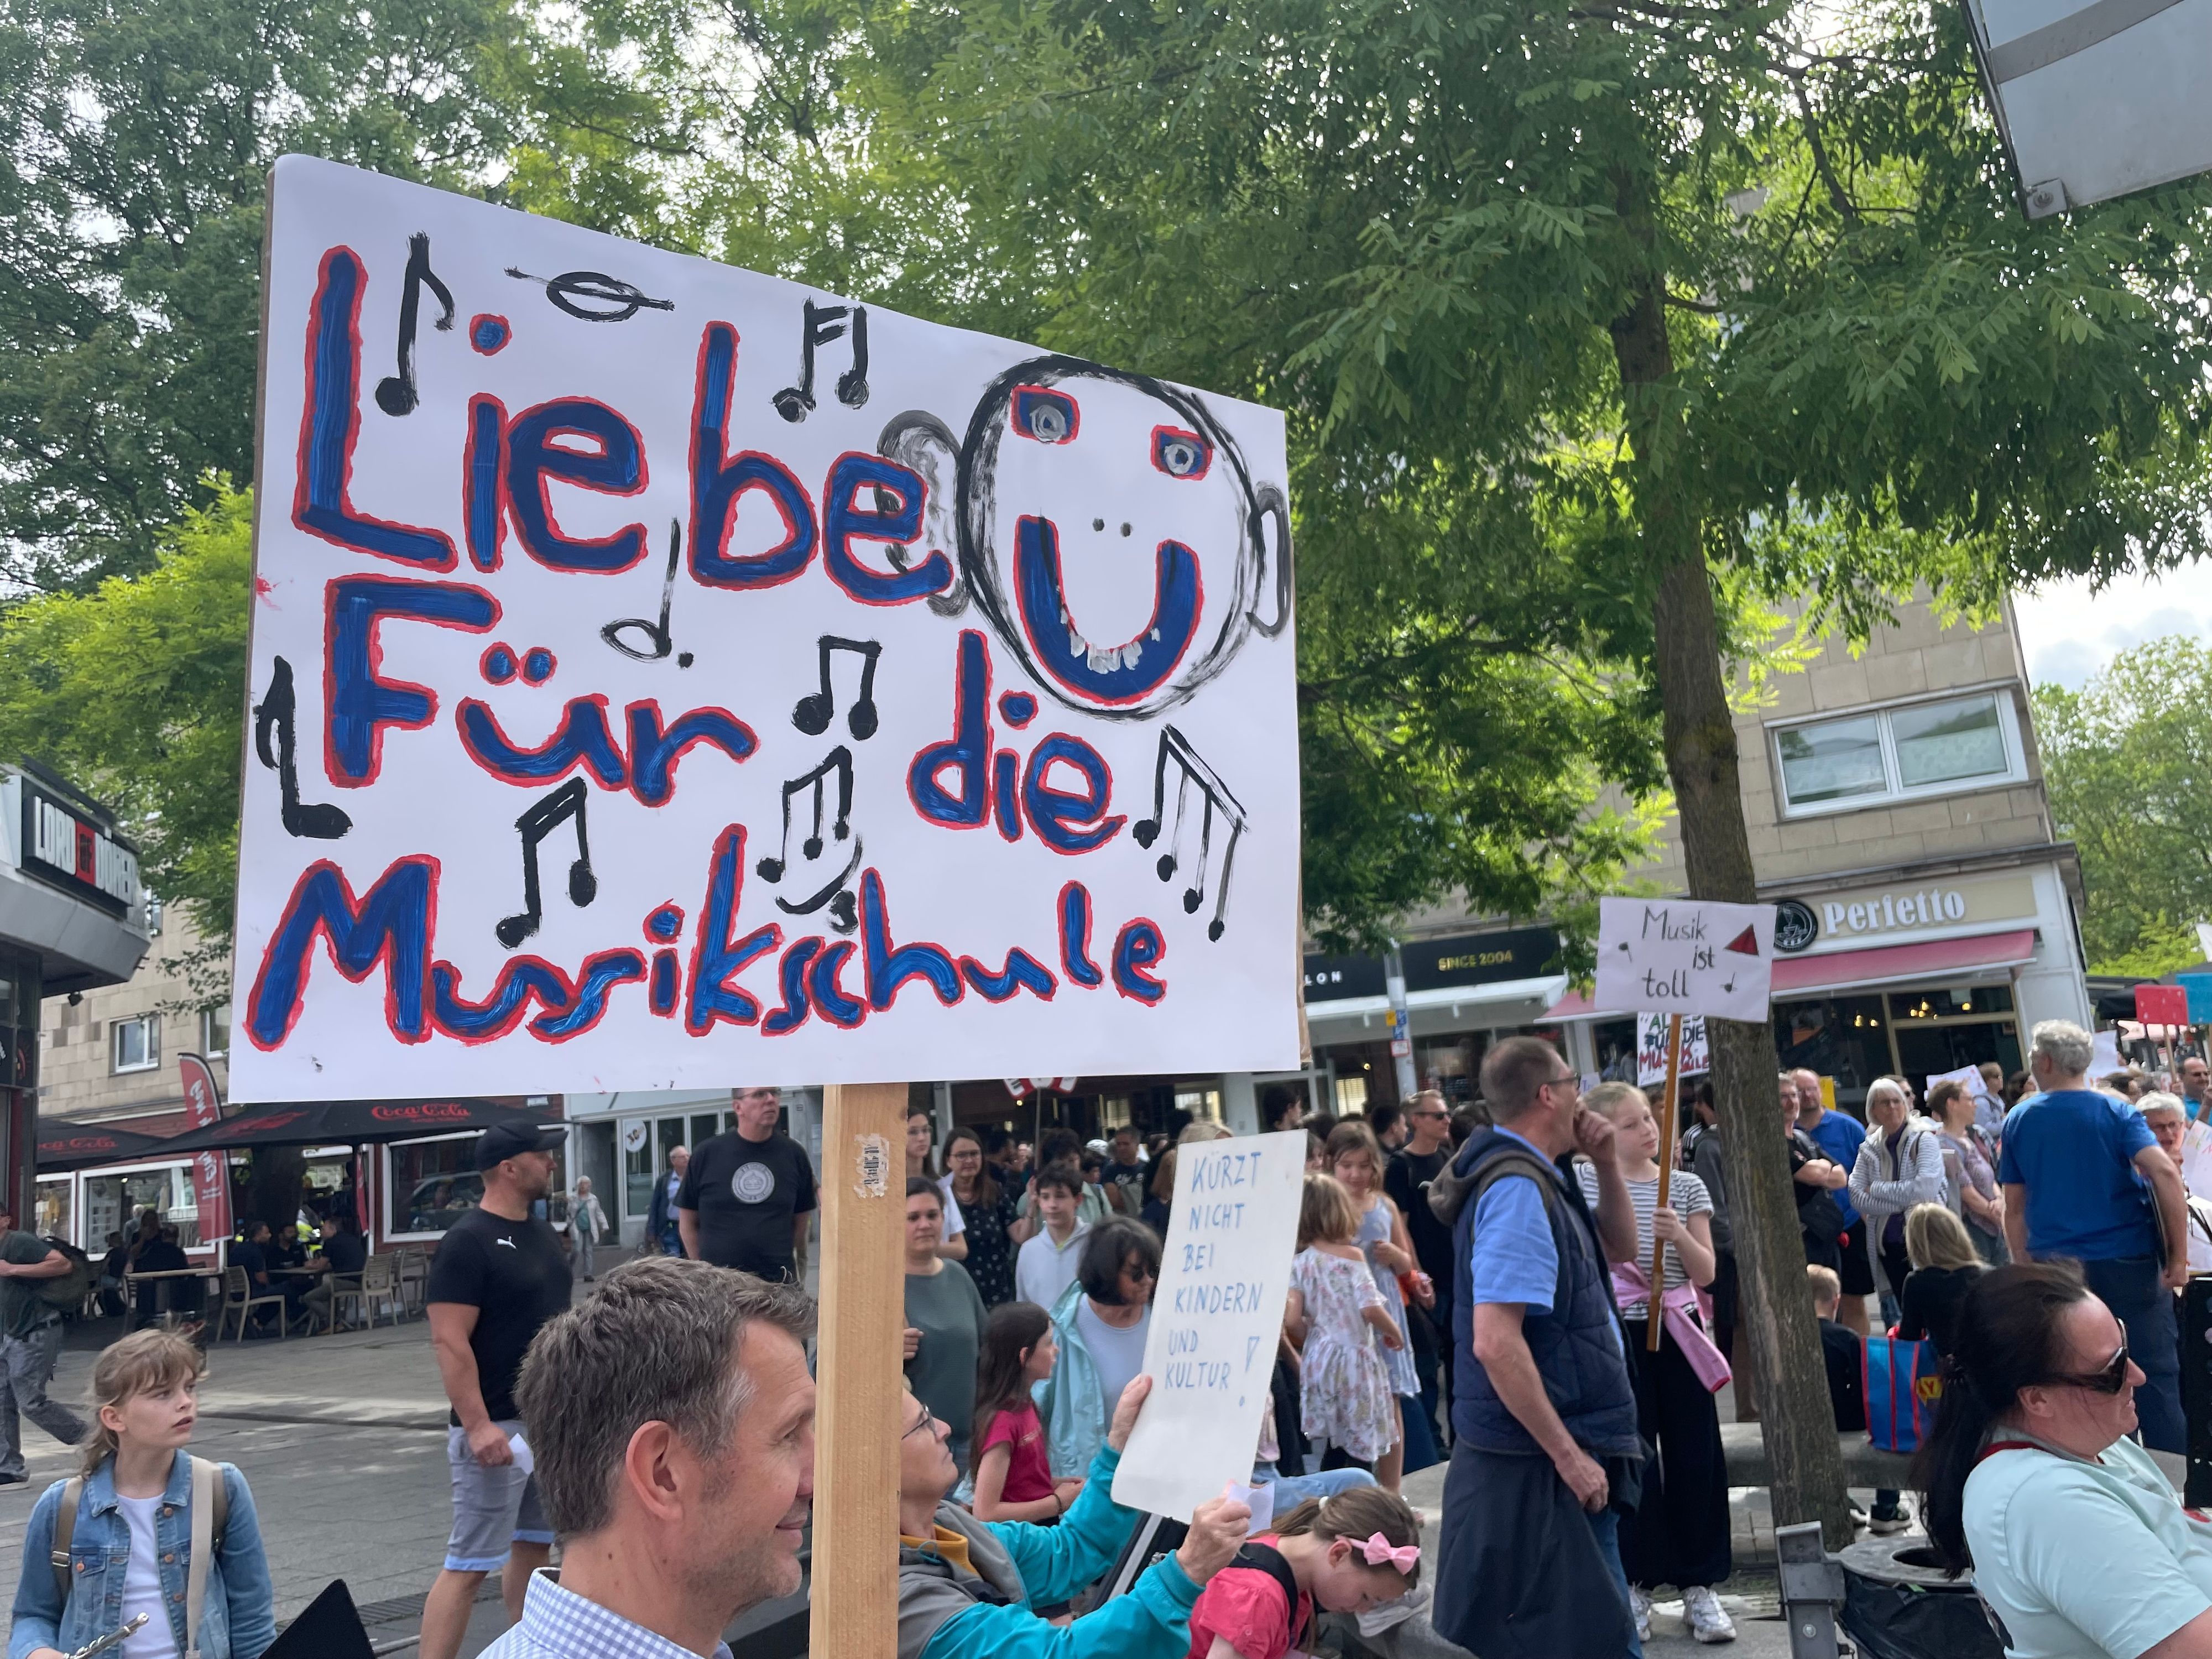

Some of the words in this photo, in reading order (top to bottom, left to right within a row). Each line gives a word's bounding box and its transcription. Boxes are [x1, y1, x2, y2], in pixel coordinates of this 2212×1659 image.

[292, 244, 954, 605] Liebe
[325, 575, 759, 808] Für
[906, 629, 1126, 854] die
[35, 795, 76, 876] LORD
[1641, 905, 1709, 940] Musik
[1821, 888, 1965, 937] Perfetto
[246, 823, 1169, 1051] Musikschule
[1438, 954, 1476, 972] SINCE
[1479, 949, 1514, 966] 2004
[1693, 943, 1716, 971] ist
[1641, 968, 1689, 998] toll
[1682, 1023, 1704, 1044] DIE
[1191, 1150, 1262, 1193] KÜRZT
[1189, 1202, 1245, 1231] NICHT
[1182, 1242, 1215, 1272] BEI
[1175, 1281, 1263, 1314] KINDERN
[1168, 1328, 1199, 1356] UND
[1164, 1361, 1231, 1390] KULTUR
